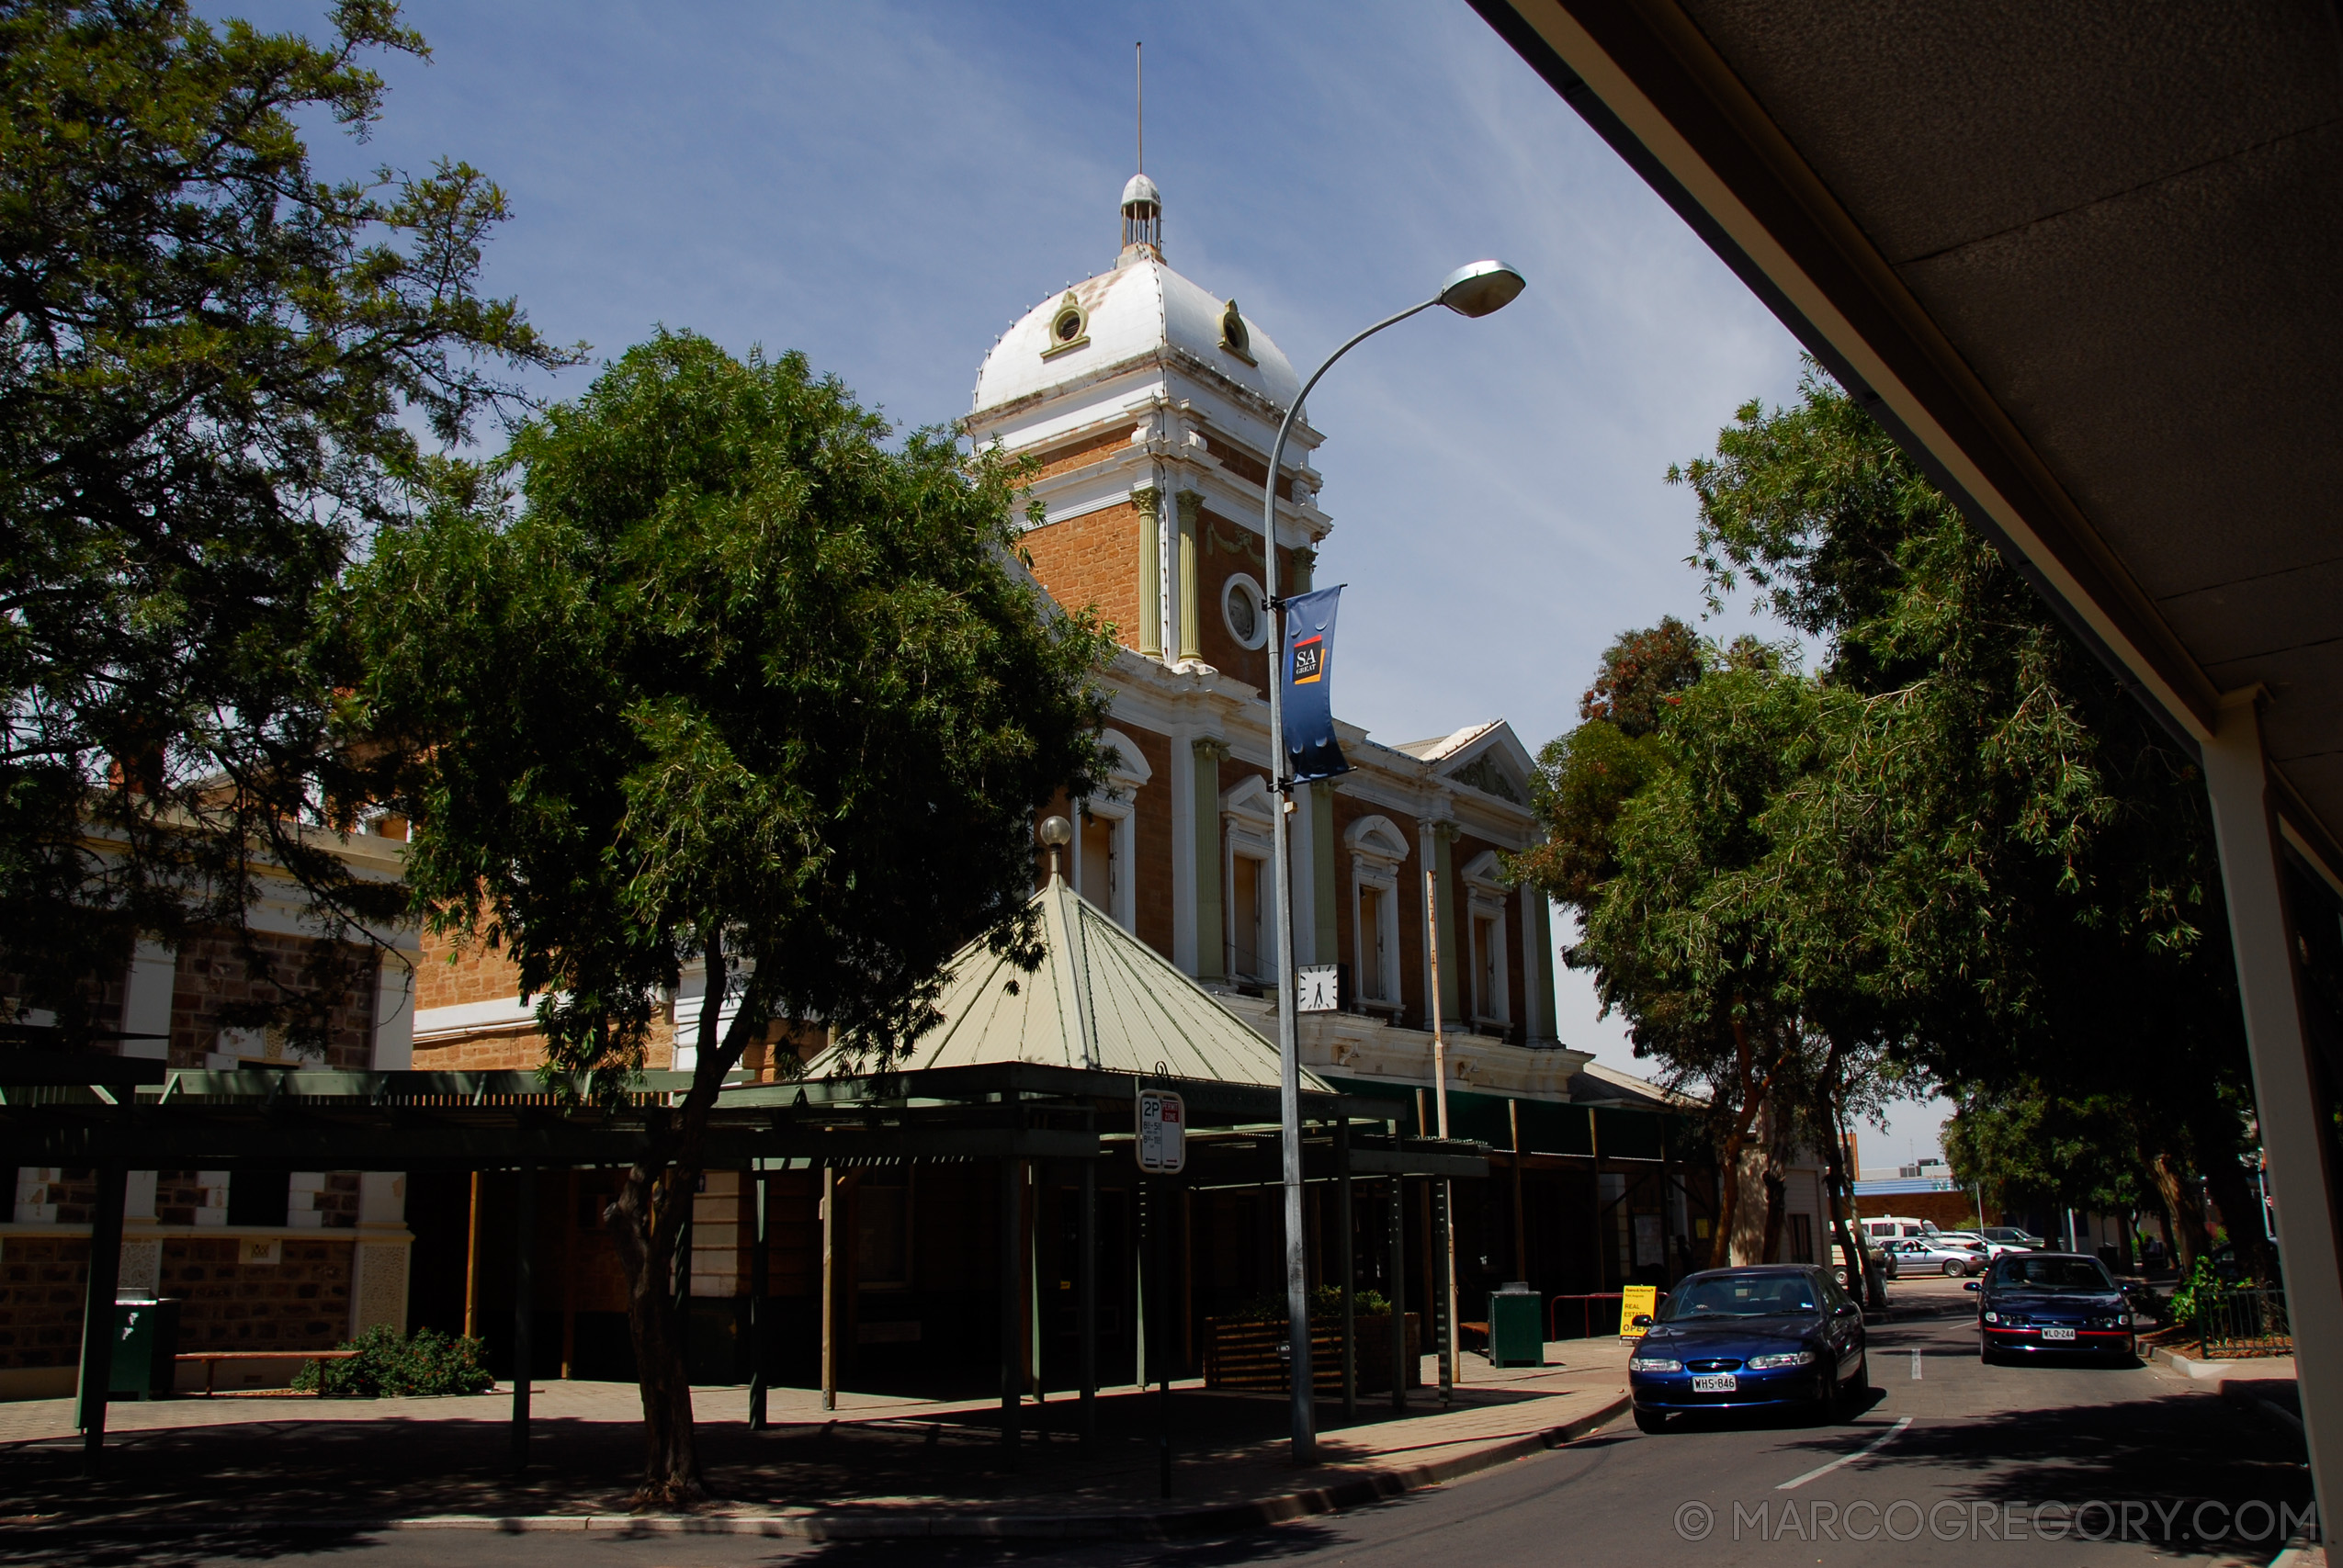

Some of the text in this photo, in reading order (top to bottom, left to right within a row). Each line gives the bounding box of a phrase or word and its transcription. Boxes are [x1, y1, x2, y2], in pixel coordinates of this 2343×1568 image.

[1296, 649, 1316, 668] SA
[1296, 664, 1316, 674] GREAT
[1144, 1101, 1160, 1117] 2P
[1161, 1101, 1178, 1111] PERMIT
[1164, 1112, 1176, 1122] ZONE
